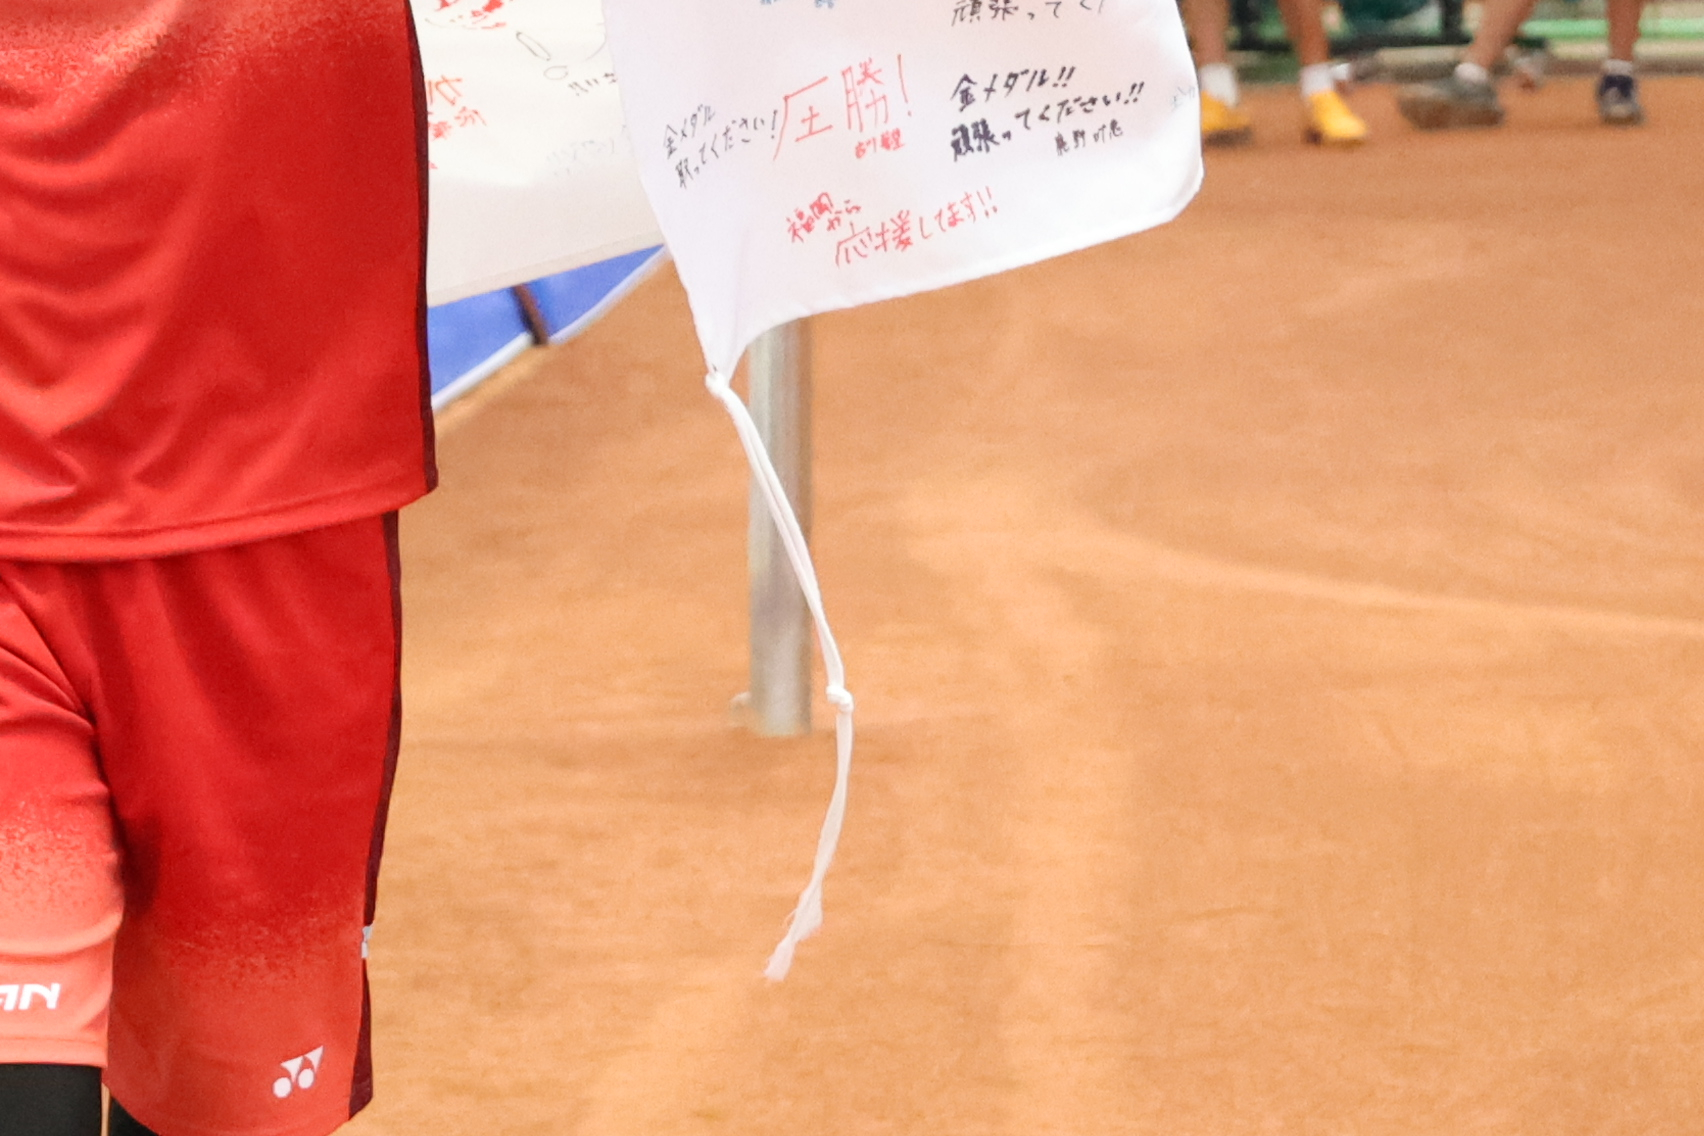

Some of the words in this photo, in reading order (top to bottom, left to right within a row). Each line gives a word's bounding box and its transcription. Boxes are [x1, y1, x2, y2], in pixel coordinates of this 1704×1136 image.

[773, 53, 914, 163] 圧勝!
[949, 64, 1078, 114] 金メダル!!
